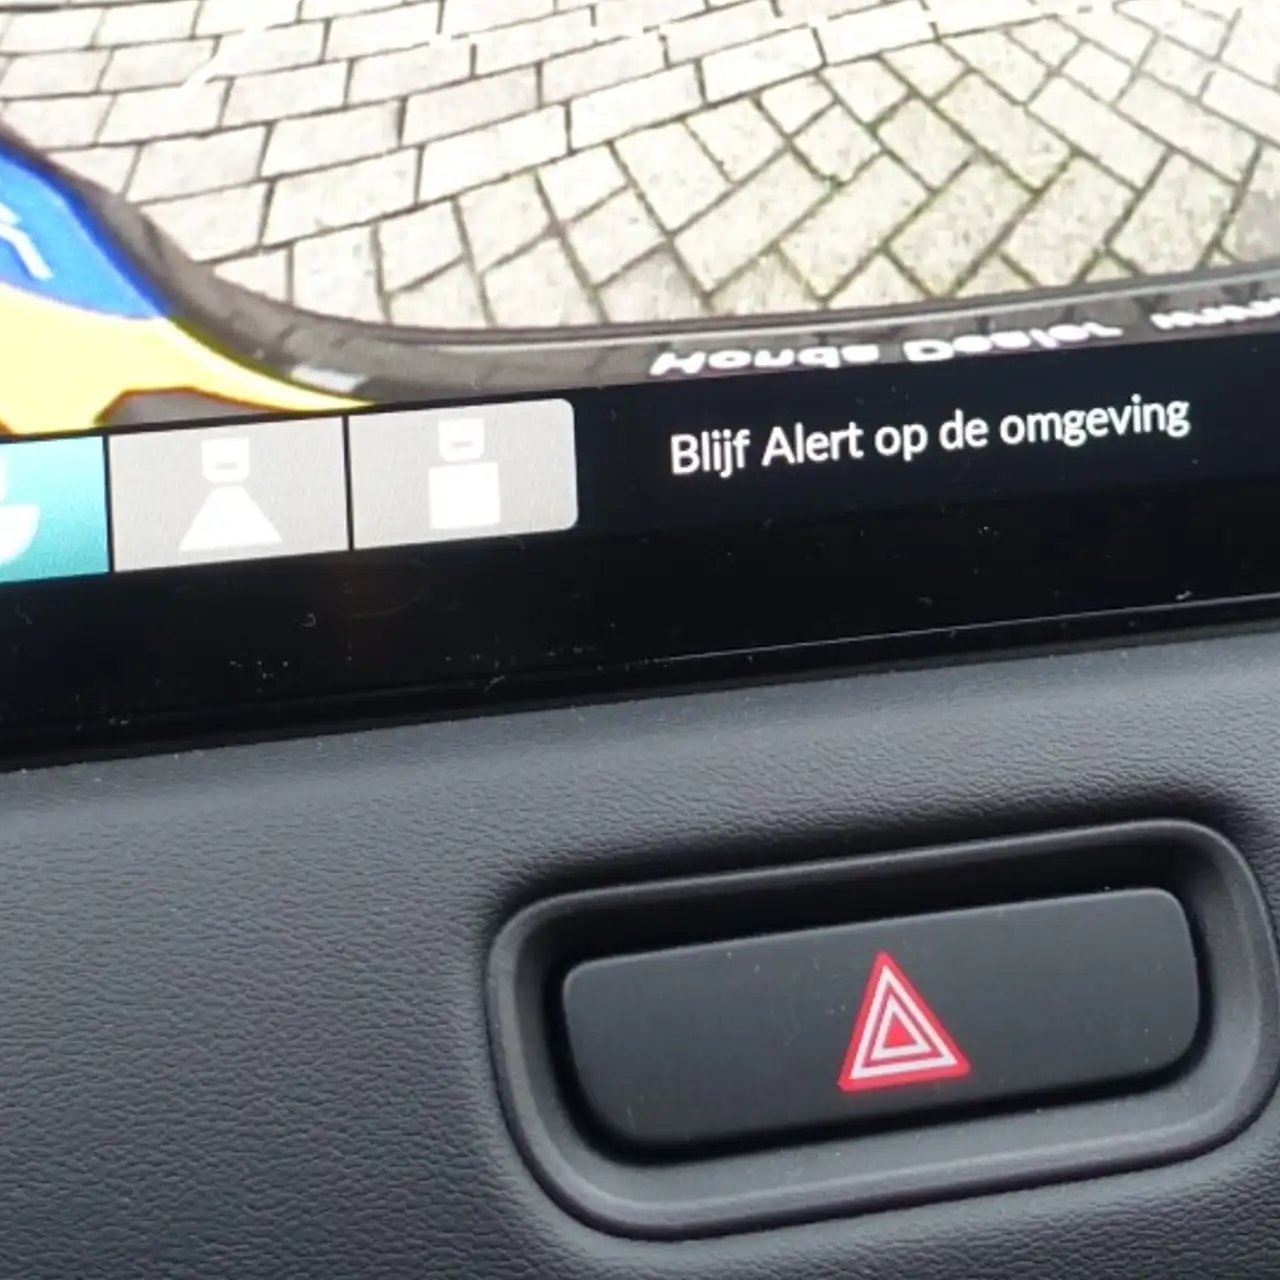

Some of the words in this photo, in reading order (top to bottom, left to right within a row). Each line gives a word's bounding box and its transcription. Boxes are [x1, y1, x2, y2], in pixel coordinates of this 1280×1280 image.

[669, 428, 750, 478] Blijf
[761, 422, 864, 467] Alert
[874, 423, 928, 461] op
[938, 409, 989, 450] de
[999, 394, 1191, 446] omgeving
